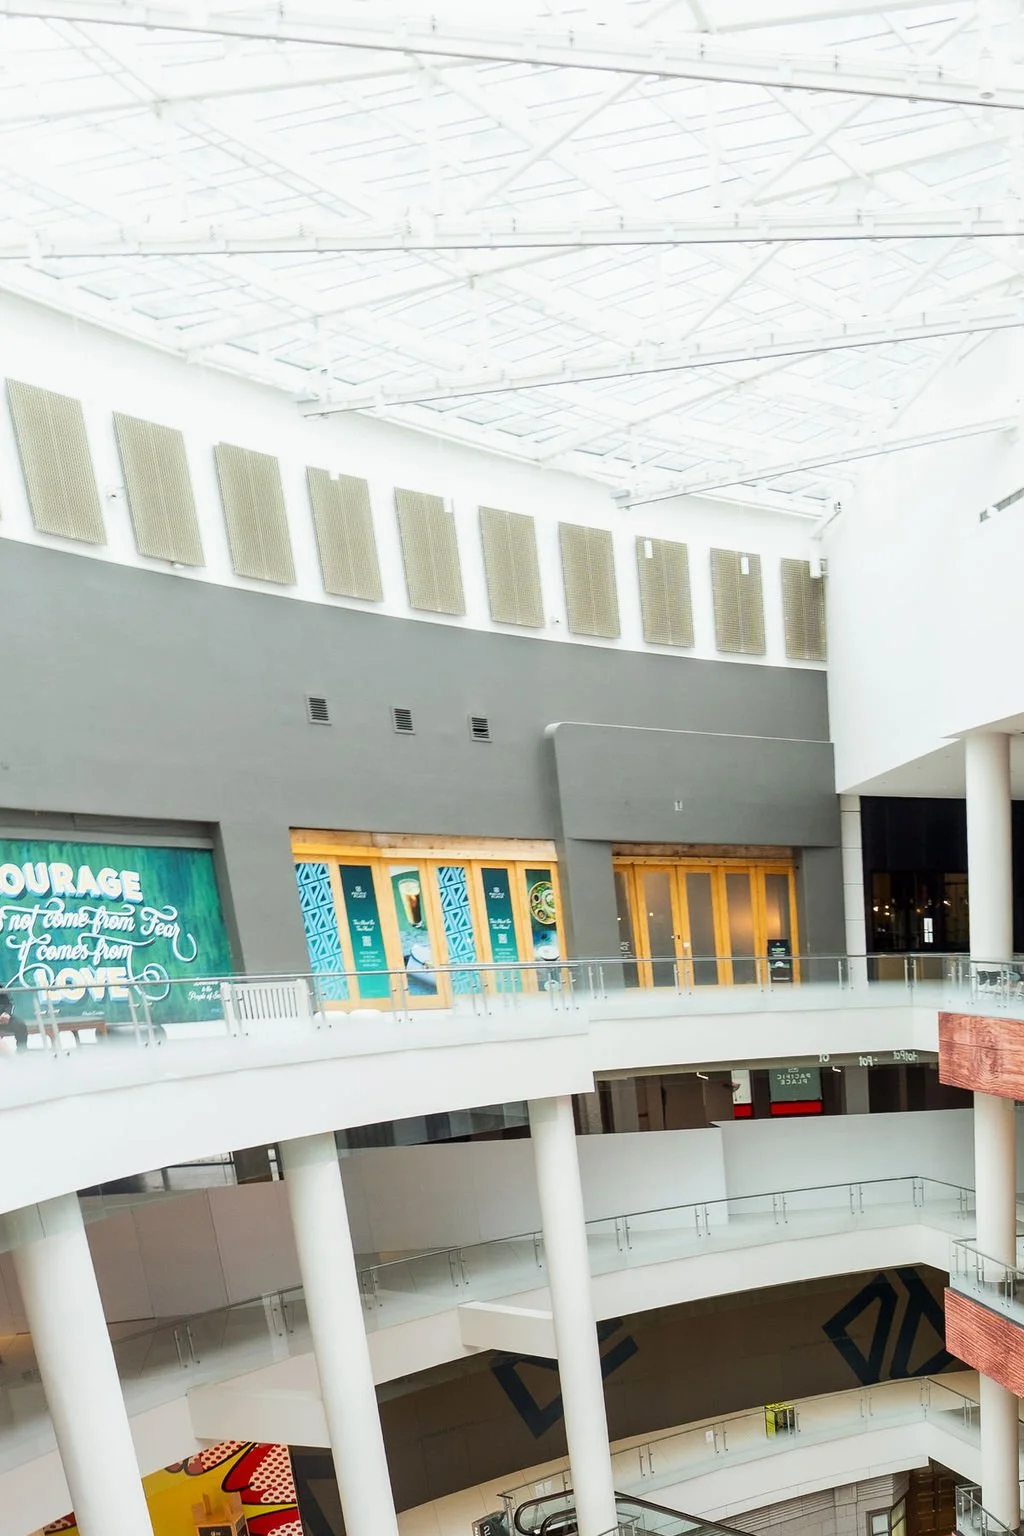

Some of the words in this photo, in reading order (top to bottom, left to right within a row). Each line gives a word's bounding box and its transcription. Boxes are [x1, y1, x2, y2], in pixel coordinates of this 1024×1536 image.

[0, 862, 143, 904] OURAGE
[8, 904, 40, 936] not
[42, 898, 91, 931] come
[82, 905, 136, 936] from
[140, 905, 191, 954] Fear
[36, 942, 92, 963] comes
[33, 966, 129, 1004] LOVE
[483, 1525, 491, 1536] 2
